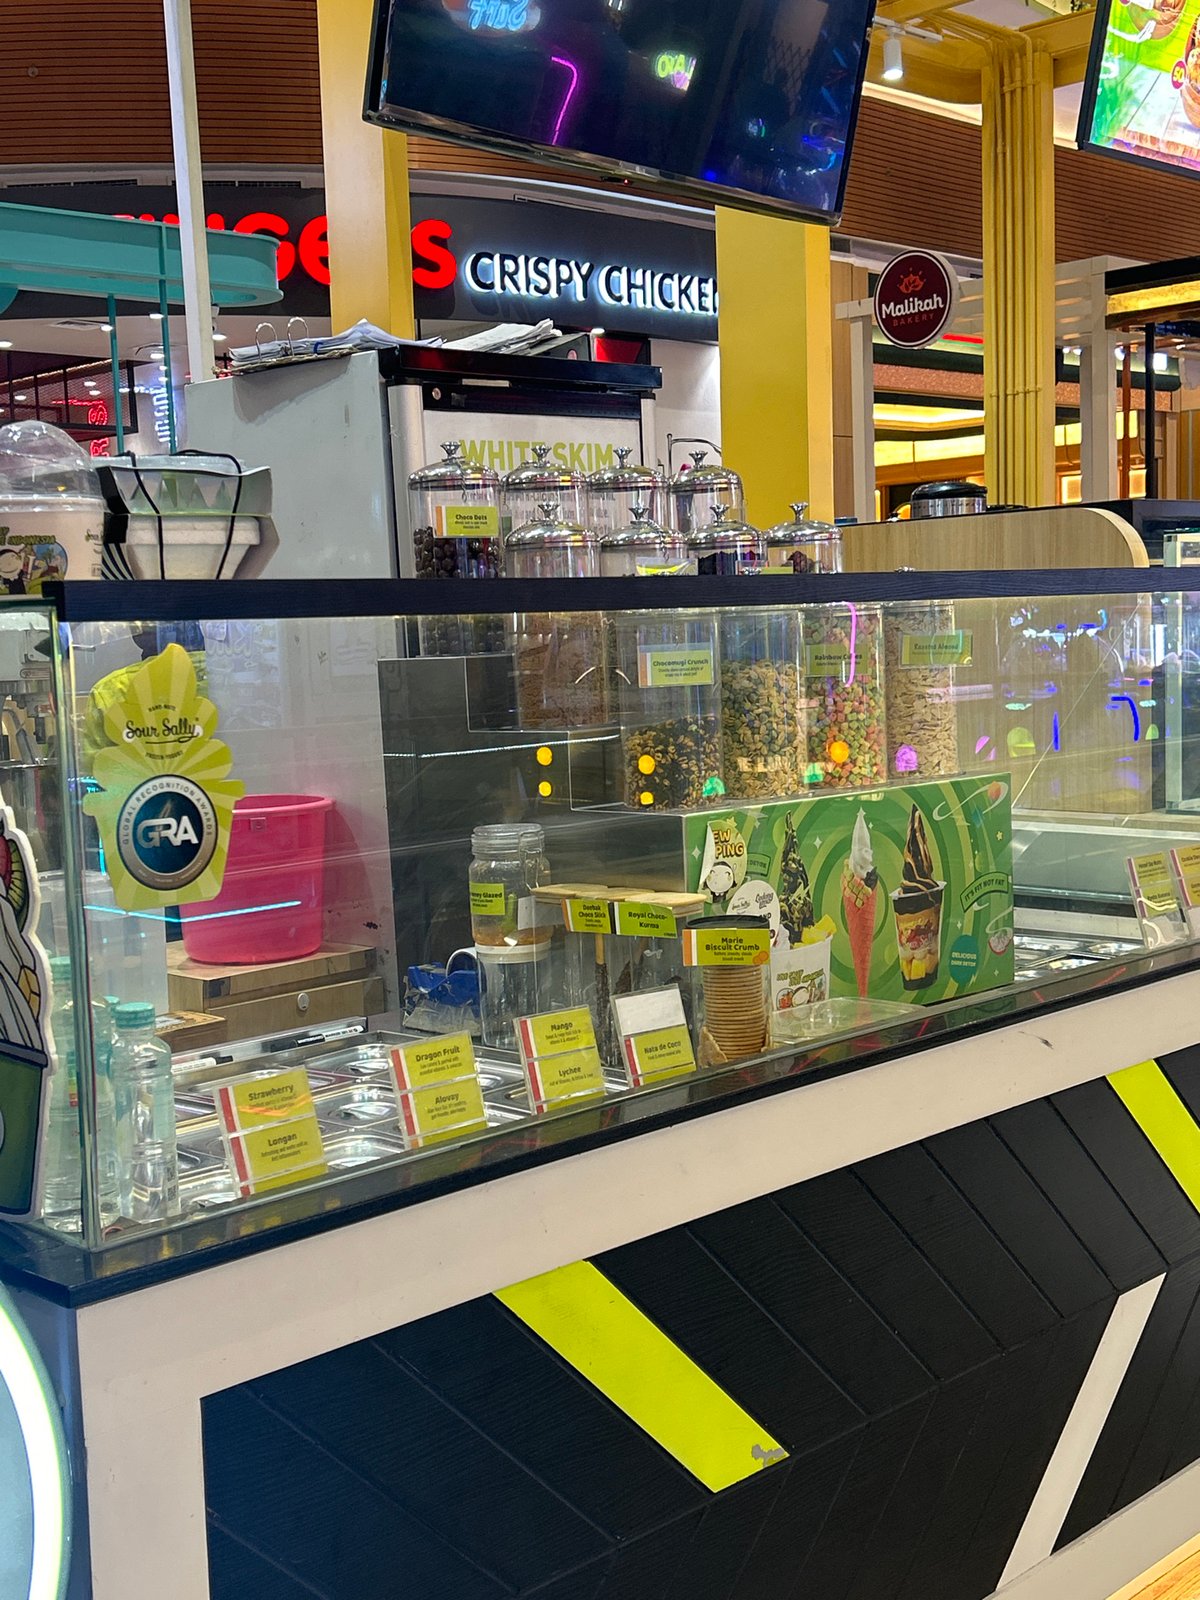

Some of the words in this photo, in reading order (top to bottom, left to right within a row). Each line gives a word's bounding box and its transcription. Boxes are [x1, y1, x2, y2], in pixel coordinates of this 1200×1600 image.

[465, 252, 594, 301] CRISPY
[881, 293, 944, 319] Malikah
[893, 313, 935, 327] BAKERY
[552, 442, 614, 472] SKIM
[455, 513, 473, 521] Choco
[653, 659, 686, 668] Chocomugi
[687, 658, 709, 666] Crunch
[814, 653, 842, 661] Rainbow
[125, 720, 160, 740] Sour
[162, 717, 200, 742] Sally
[123, 804, 137, 846] GLOBAL
[136, 782, 196, 803] RECOGNITION
[197, 798, 213, 837] AWARDS
[137, 815, 199, 849] GRA
[712, 829, 731, 844] EW
[715, 842, 745, 859] PING
[982, 878, 994, 887] NOT
[482, 891, 502, 899] Glazed
[578, 911, 594, 919] Choco
[627, 911, 647, 920] Royal
[647, 911, 668, 920] Choco-
[705, 943, 732, 951] Biscuit
[733, 943, 760, 951] Crumb
[550, 1021, 573, 1032] Mango
[415, 1049, 442, 1063] Dragon
[443, 1044, 460, 1057] Fruit
[643, 1045, 659, 1054] Nata
[659, 1043, 667, 1051] de
[667, 1040, 682, 1050] Coco
[558, 1065, 582, 1078] Lychee
[248, 1083, 294, 1102] Strawberry
[267, 1132, 298, 1148] Longan
